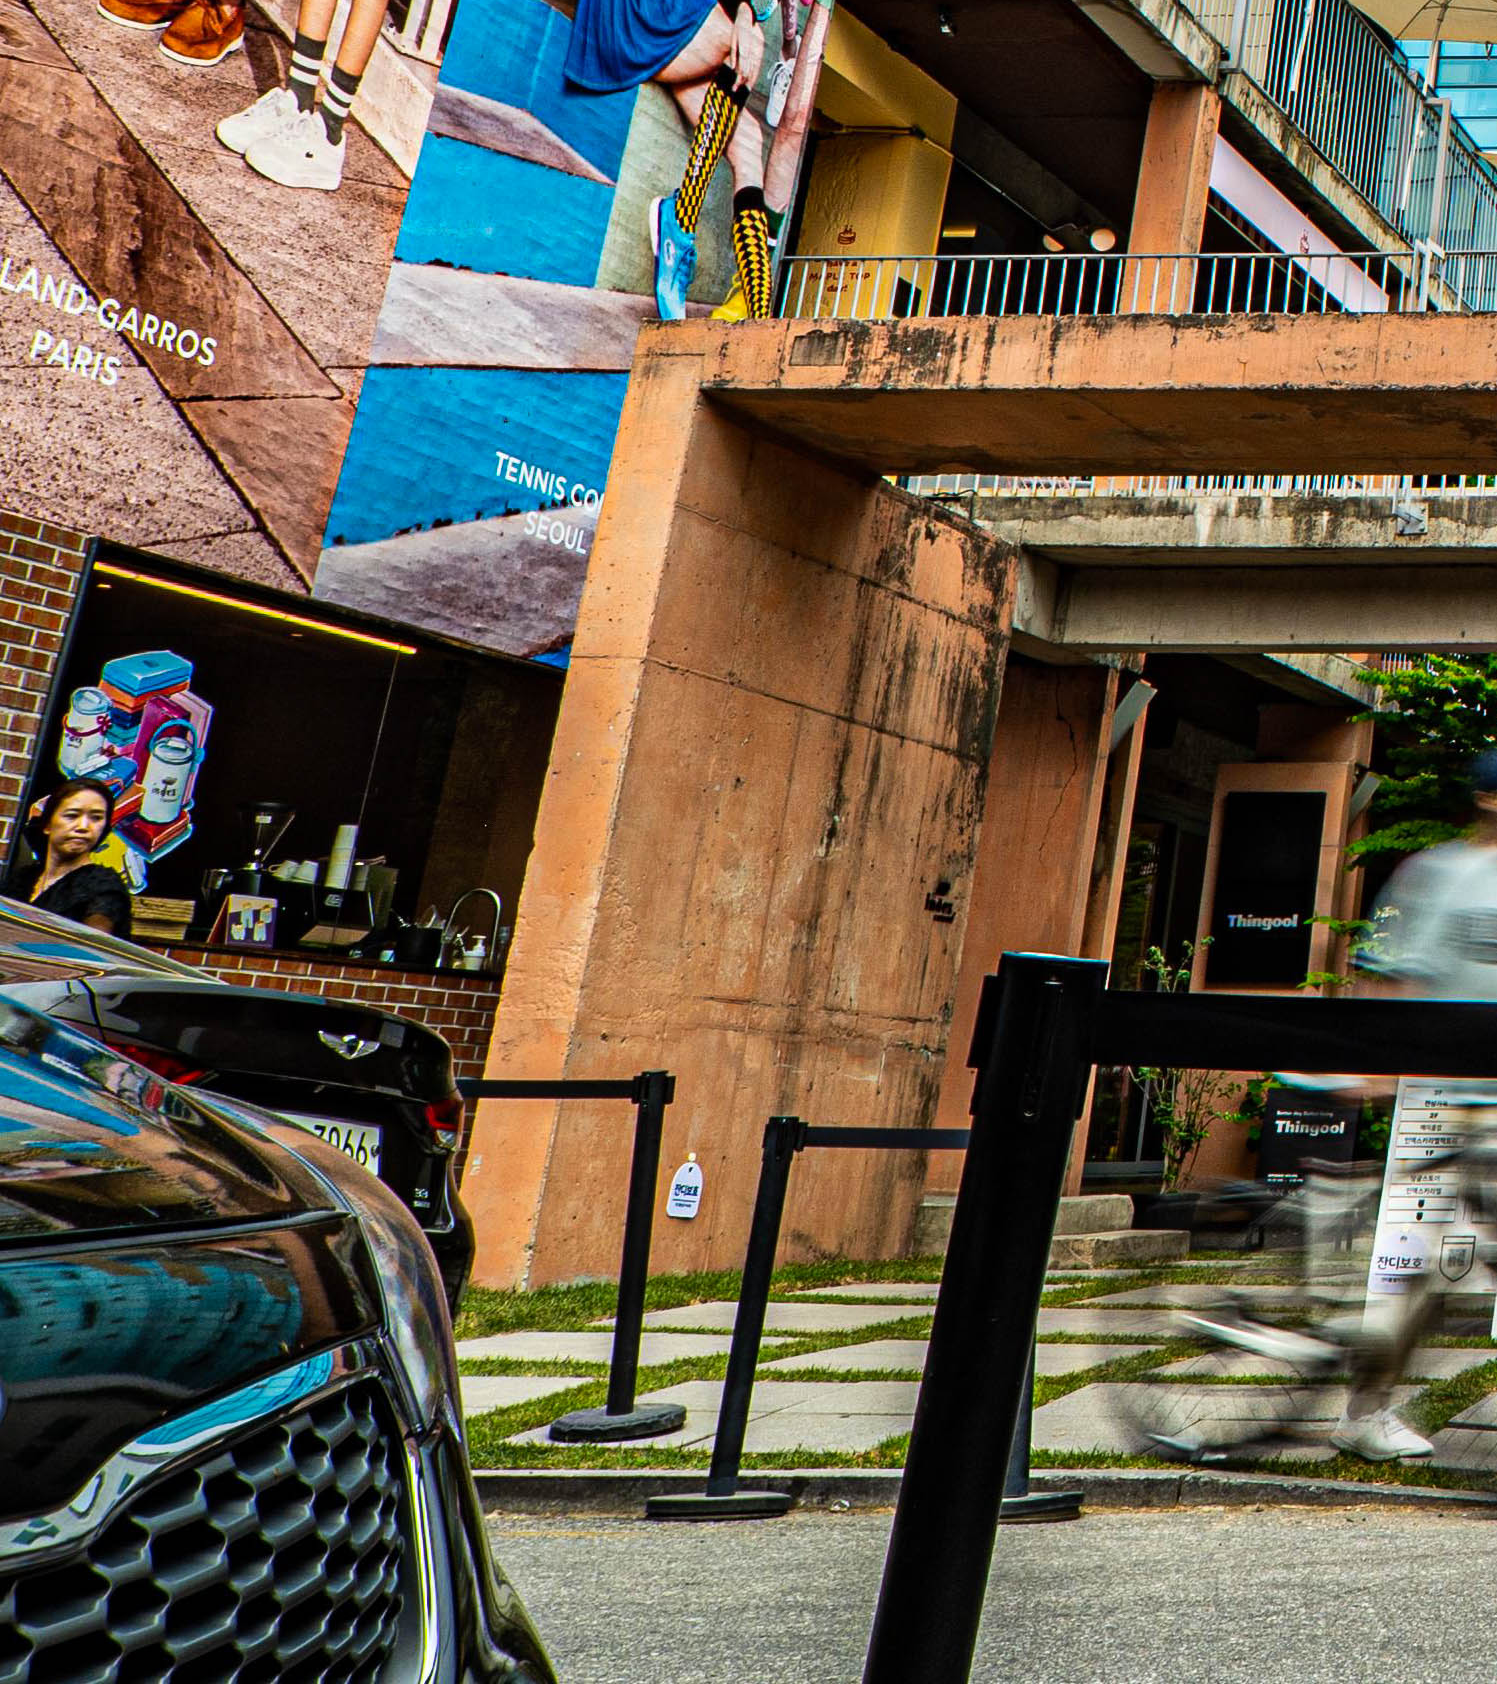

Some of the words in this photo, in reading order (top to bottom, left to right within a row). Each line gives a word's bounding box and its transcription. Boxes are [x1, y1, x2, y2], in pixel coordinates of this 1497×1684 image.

[30, 329, 122, 386] PARIS
[496, 451, 567, 500] TENNIS
[524, 511, 586, 555] SEOUL
[1227, 913, 1299, 930] Thingool
[1275, 1119, 1345, 1136] Thingool
[1377, 1256, 1423, 1270] 잔디보호
